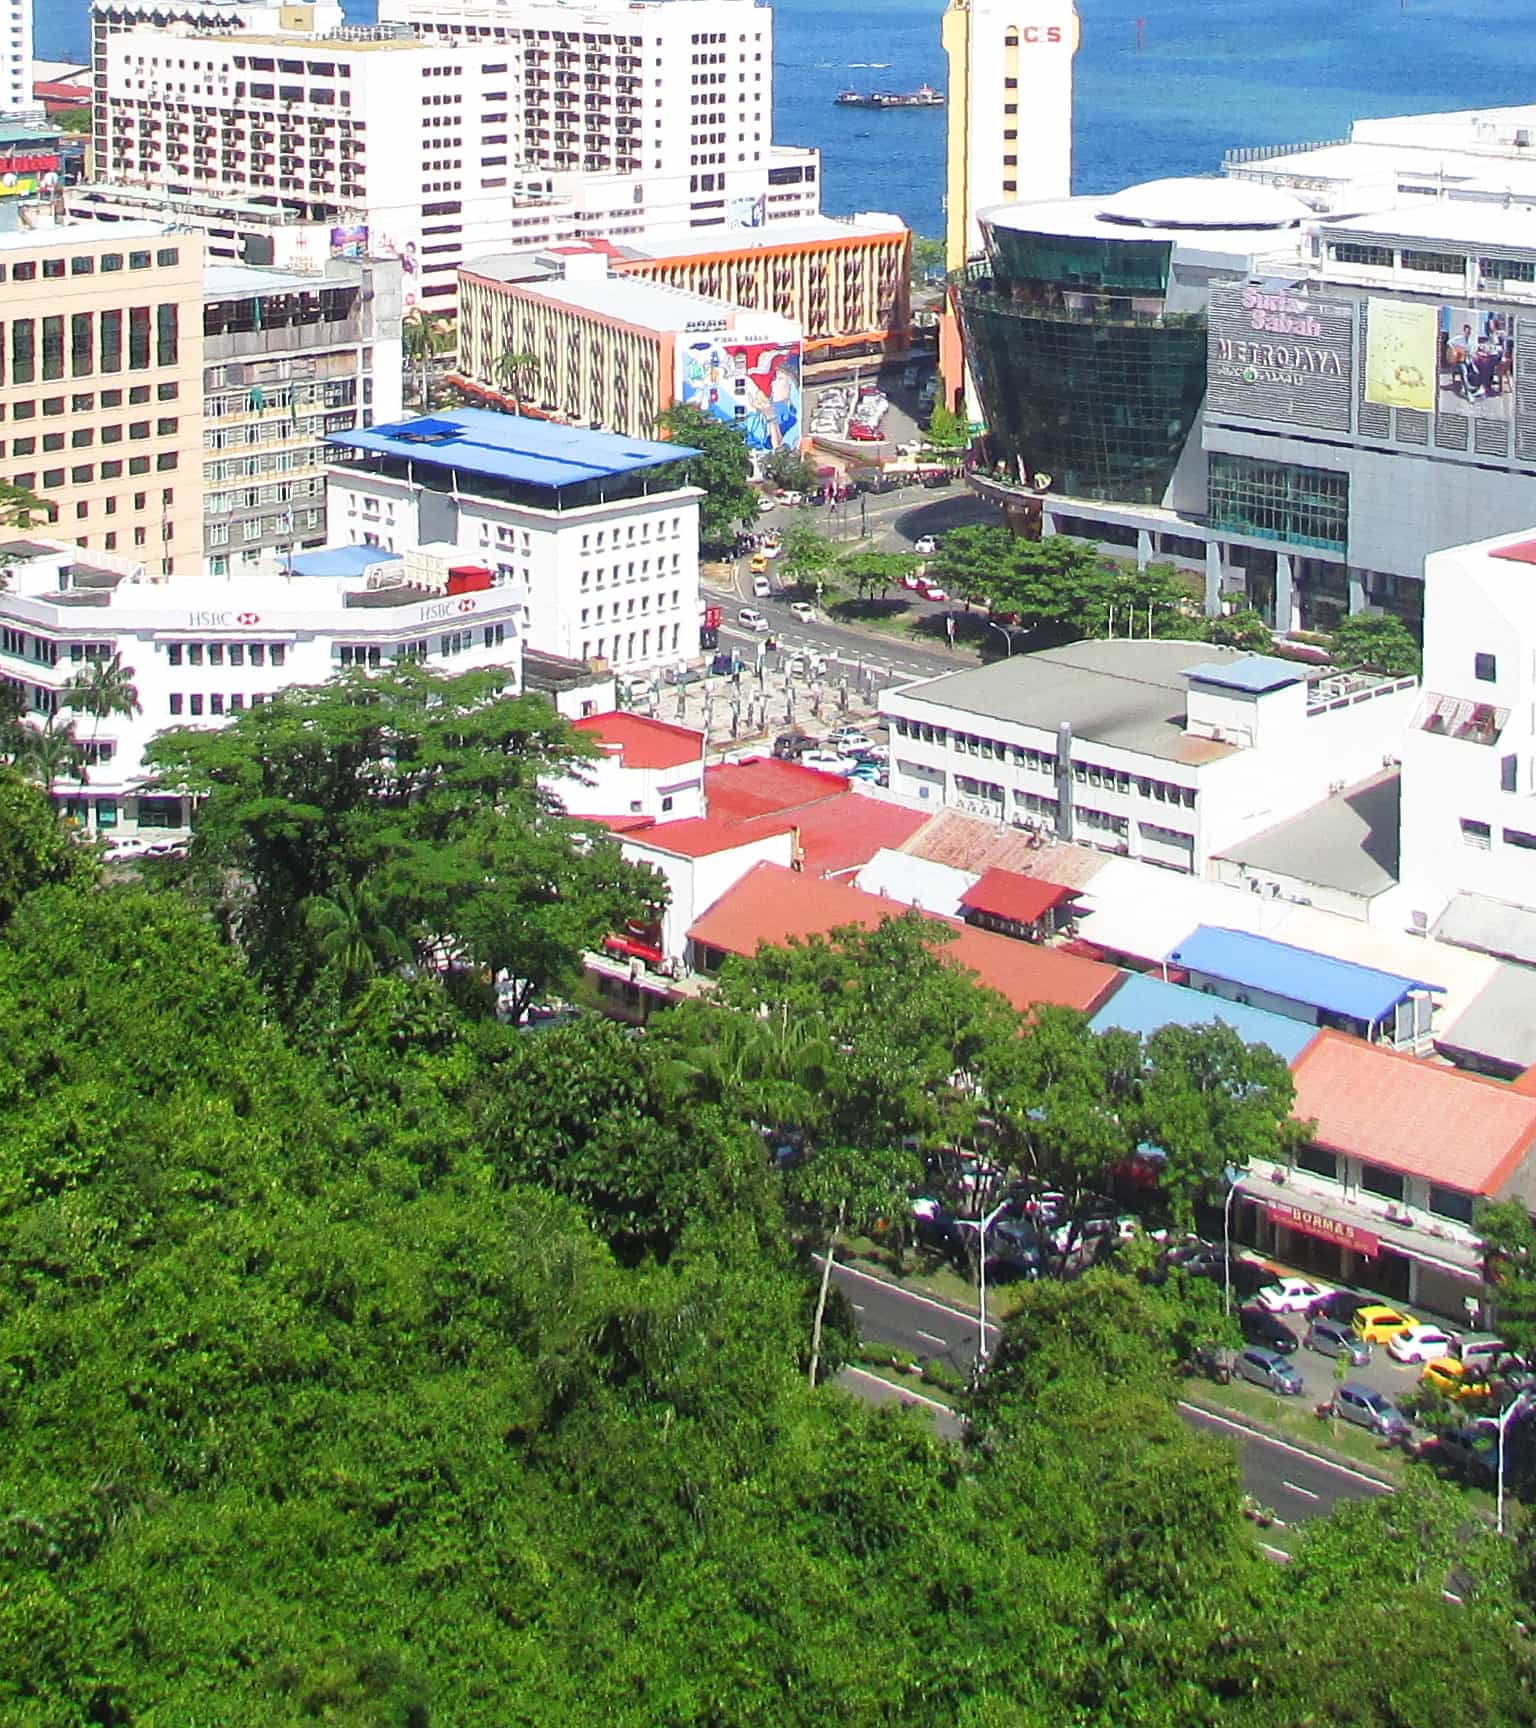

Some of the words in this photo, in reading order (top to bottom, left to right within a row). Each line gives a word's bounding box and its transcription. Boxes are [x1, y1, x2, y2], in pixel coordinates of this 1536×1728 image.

[1244, 287, 1299, 313] Suria
[1251, 311, 1321, 337] Sabah
[1216, 338, 1342, 376] METROJAYA
[189, 612, 233, 626] HSBC
[420, 602, 454, 621] HSBC
